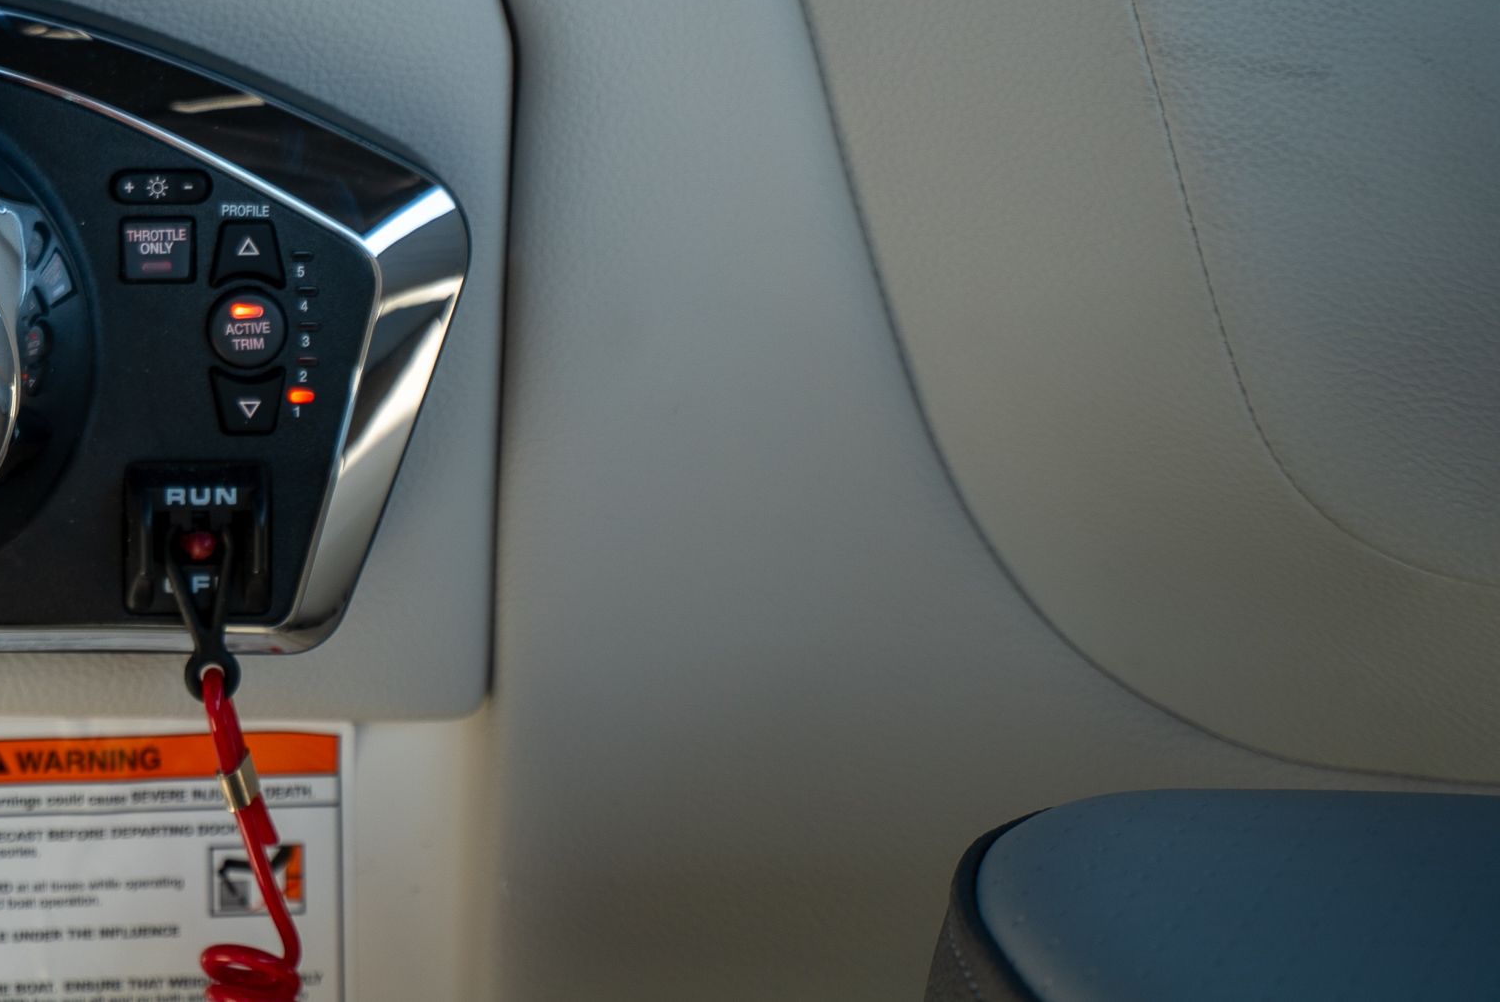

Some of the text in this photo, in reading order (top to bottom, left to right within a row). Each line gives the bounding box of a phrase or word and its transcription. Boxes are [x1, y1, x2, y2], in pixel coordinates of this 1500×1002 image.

[221, 205, 270, 217] PROFILE
[126, 228, 186, 242] THROTTLE
[140, 241, 172, 255] ONLY
[297, 265, 305, 278] 5
[300, 300, 309, 313] 4
[225, 322, 270, 336] ACTIVE
[232, 337, 265, 351] TRIM
[301, 335, 310, 348] 3
[299, 370, 308, 383] 2
[293, 406, 300, 419] 1
[166, 487, 238, 505] RUN
[16, 747, 161, 773] WARNING
